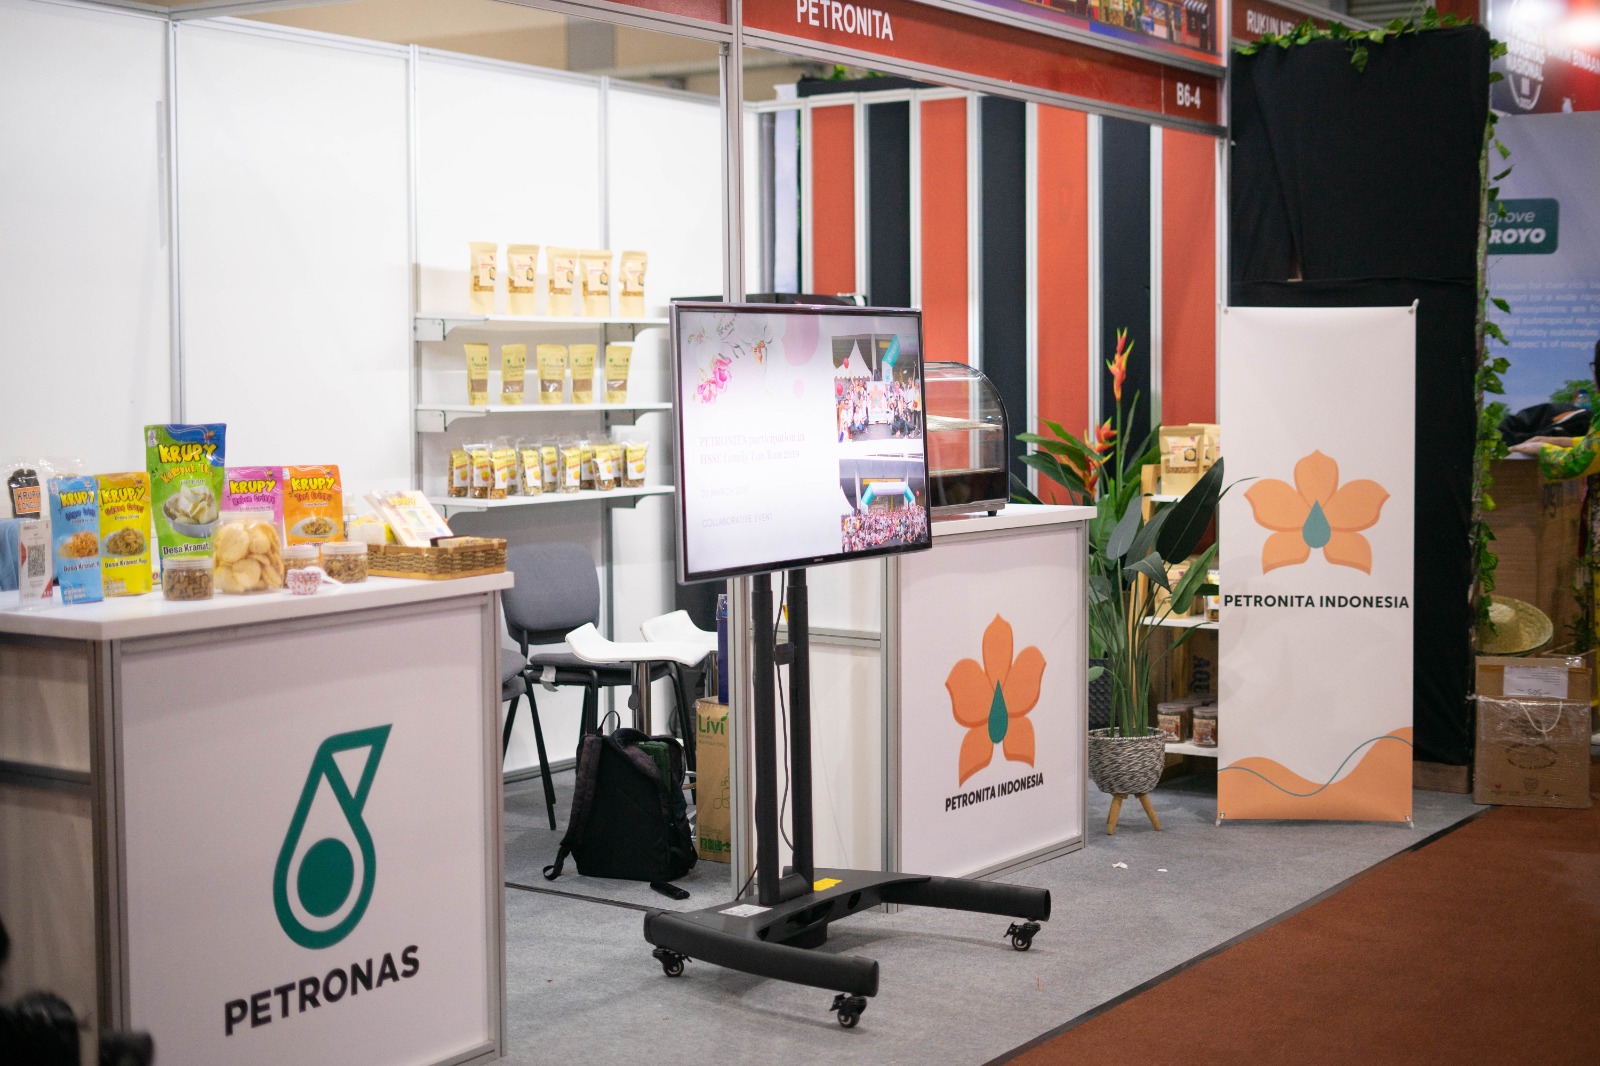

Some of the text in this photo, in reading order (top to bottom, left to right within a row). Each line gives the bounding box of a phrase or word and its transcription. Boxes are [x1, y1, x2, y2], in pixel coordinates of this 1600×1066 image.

[796, 0, 894, 41] PETRONITA
[1176, 81, 1201, 109] B6-4
[1488, 228, 1546, 245] ROYO
[158, 442, 218, 464] KRUPY
[229, 479, 277, 496] KRUPY
[291, 476, 335, 494] KRUPY
[58, 488, 95, 508] KRUPY
[99, 486, 147, 505] KRUPY
[162, 545, 183, 556] Desa
[1223, 594, 1410, 609] PETRONITA INDONESIA
[945, 771, 1044, 813] PETRONITA INDONESIA
[224, 944, 421, 1037] PETRONAS
